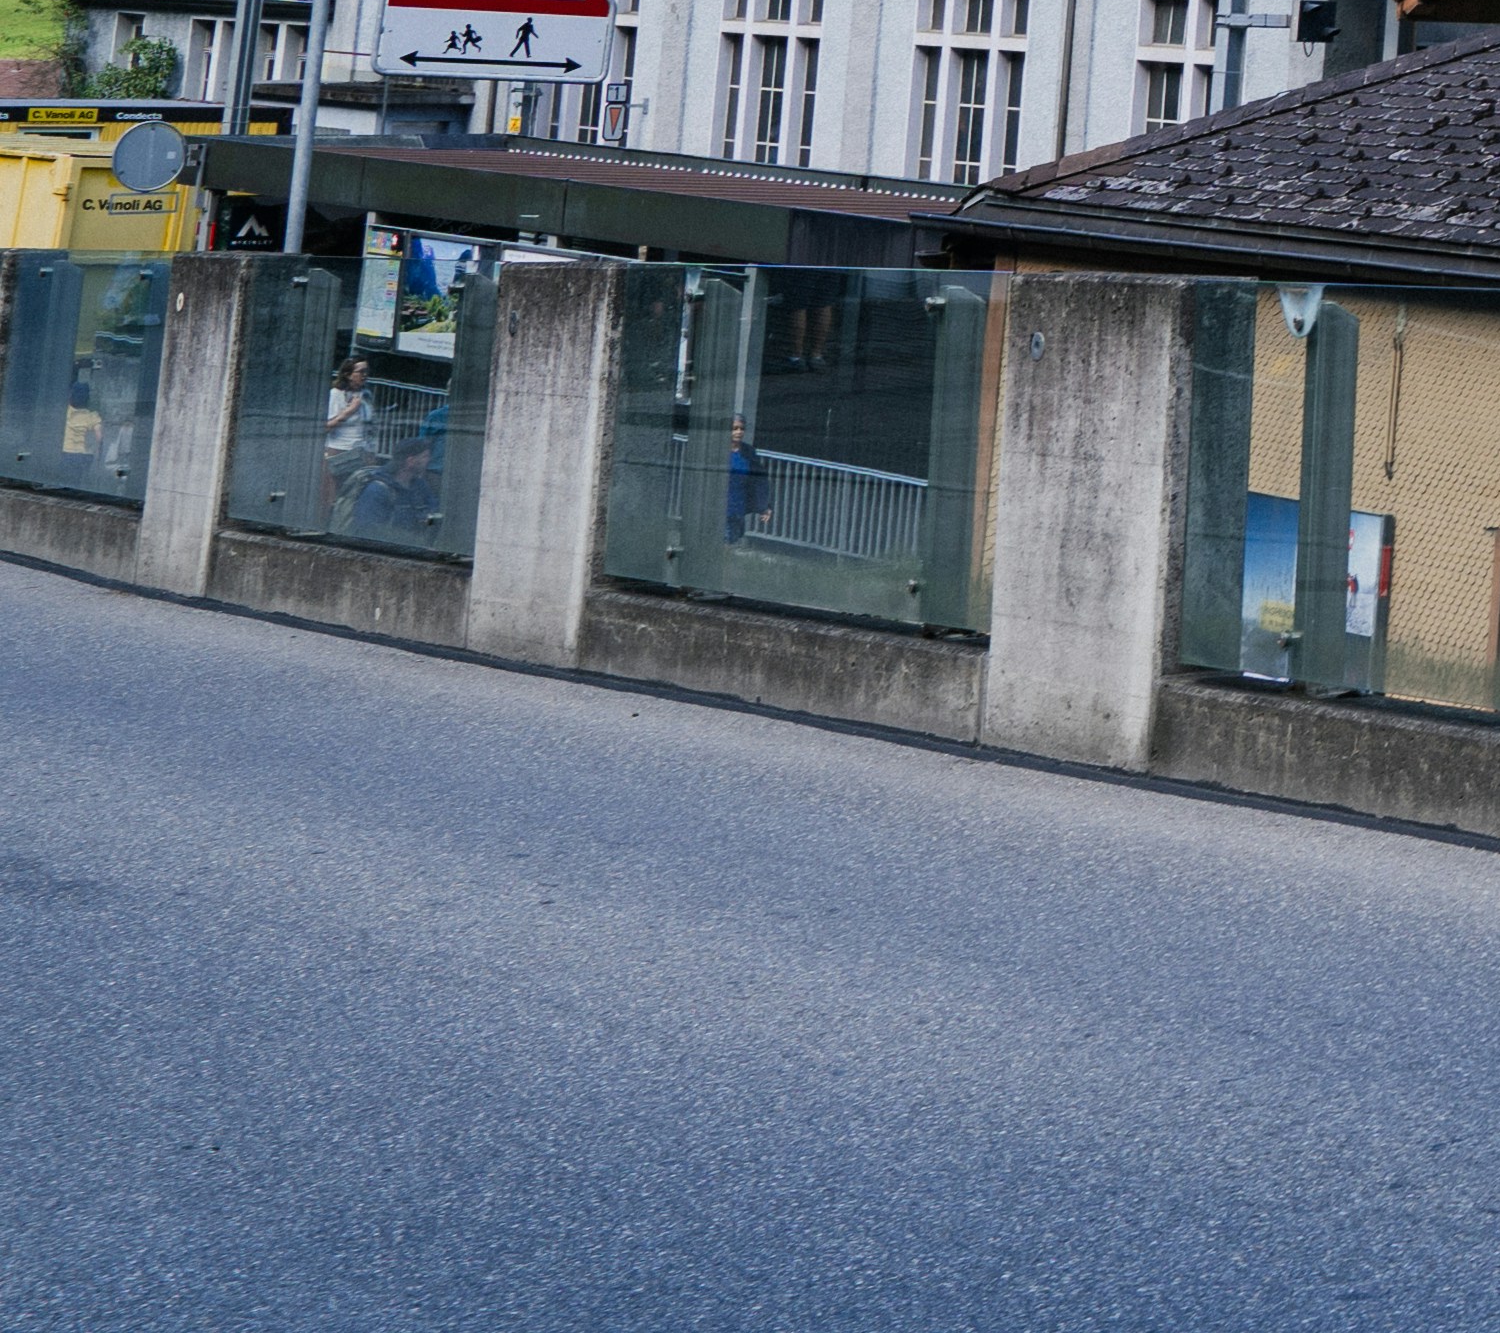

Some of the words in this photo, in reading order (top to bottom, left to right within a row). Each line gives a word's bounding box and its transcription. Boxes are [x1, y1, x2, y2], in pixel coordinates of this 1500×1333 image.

[32, 110, 43, 119] C.
[46, 110, 75, 119] Vanoli
[78, 110, 94, 120] AG
[116, 111, 162, 120] Condecta
[82, 198, 95, 211] C.
[143, 199, 163, 211] AG
